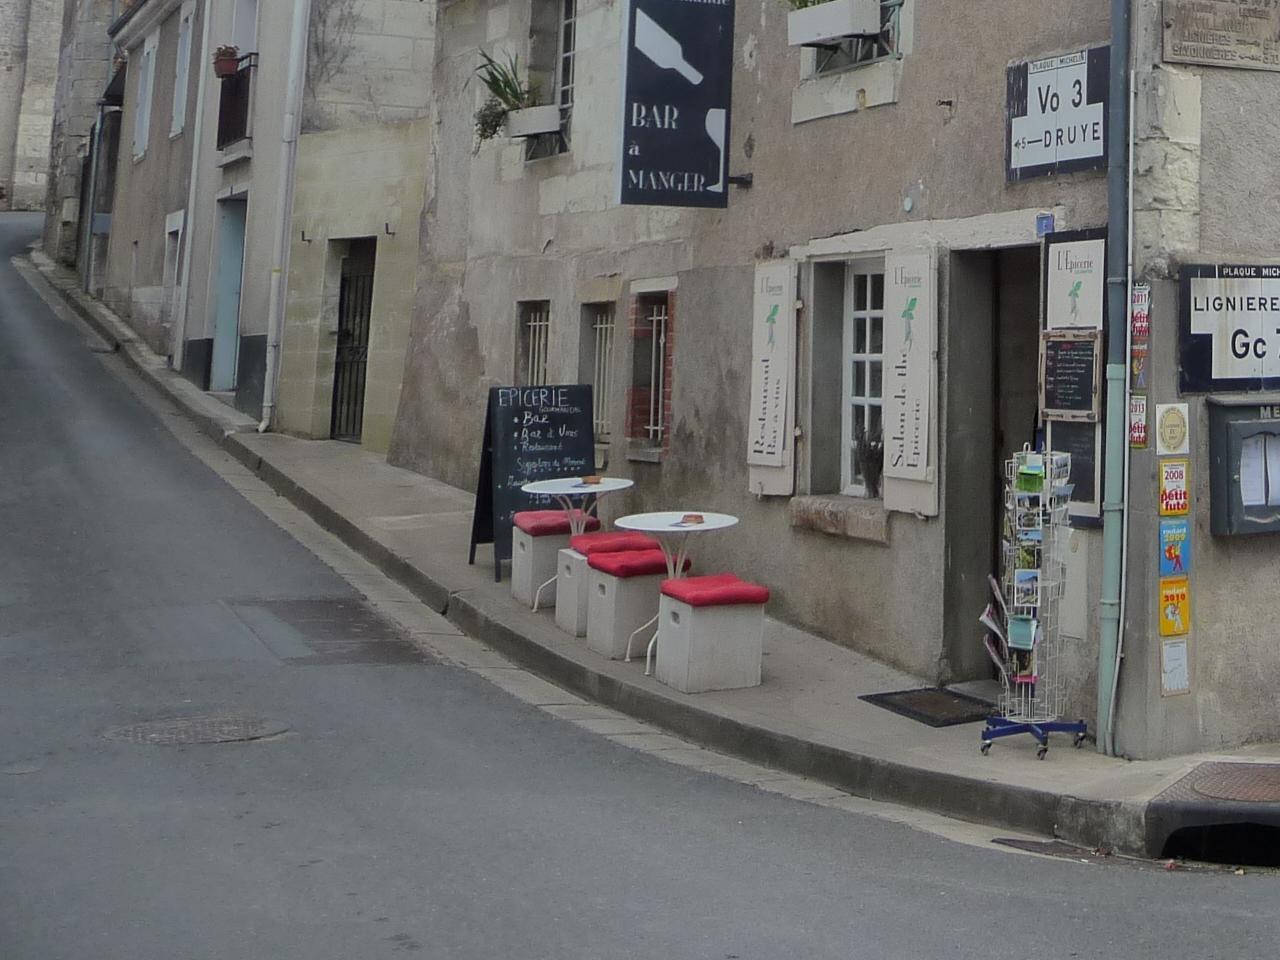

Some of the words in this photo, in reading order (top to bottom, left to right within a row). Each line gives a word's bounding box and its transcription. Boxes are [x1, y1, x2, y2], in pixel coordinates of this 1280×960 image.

[1032, 60, 1055, 71] PLAQUE
[1059, 51, 1085, 65] MICHELIN
[1072, 79, 1083, 108] 3
[632, 103, 679, 129] BAR
[1044, 122, 1100, 148] DRUYE
[629, 140, 640, 156] à
[628, 169, 705, 192] MANGER
[1222, 267, 1256, 276] PLAQUE
[1231, 328, 1267, 360] Gc
[498, 388, 569, 408] EPICERIE
[753, 358, 770, 454] Restaurant
[894, 384, 906, 406] de
[892, 412, 904, 467] Salon
[907, 398, 920, 468] Epicerie
[1164, 470, 1184, 481] 2008
[1164, 593, 1186, 602] 2010
